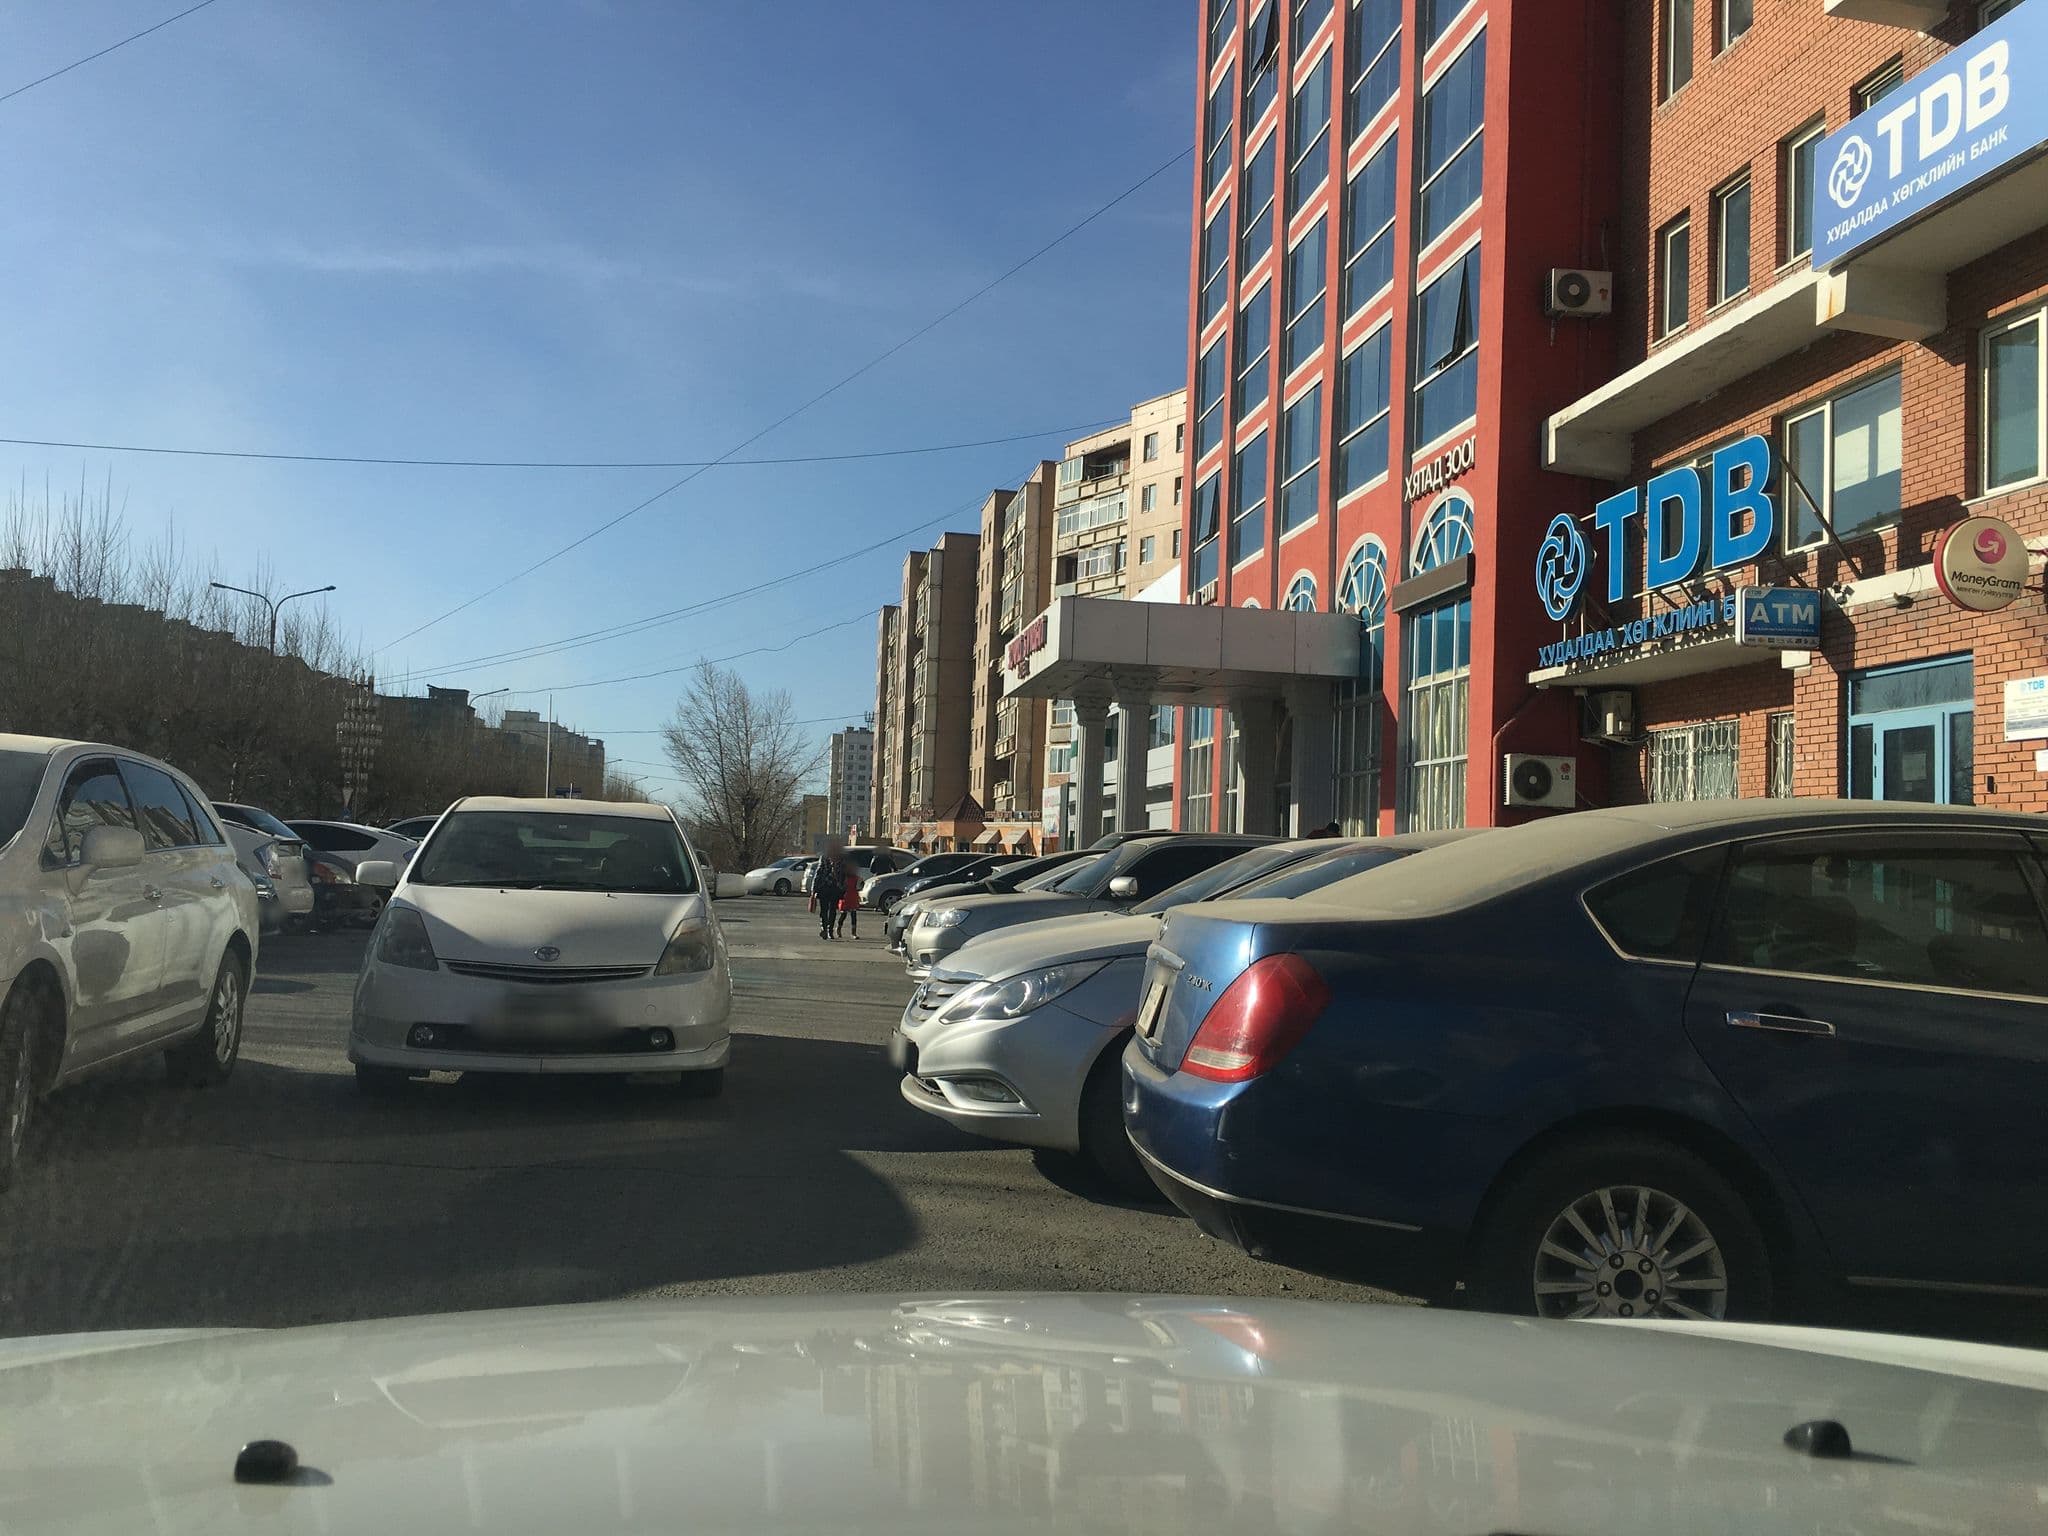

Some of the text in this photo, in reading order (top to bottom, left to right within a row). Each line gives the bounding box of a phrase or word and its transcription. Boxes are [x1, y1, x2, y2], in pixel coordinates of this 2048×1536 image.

[1877, 39, 2009, 179] TDB
[1827, 125, 2008, 244] ХУДАЛДАА ХӨГЖЛИЙН БАНК
[1404, 456, 1443, 502] ХЯТАД
[1595, 434, 1774, 603] TDB
[1951, 570, 2021, 590] MoneyGram
[1538, 628, 1616, 668] ХУДАЛДАА
[1623, 592, 1715, 644] ХӨГЖЛИЙН
[1750, 602, 1815, 625] ATM
[2027, 680, 2046, 690] TDB
